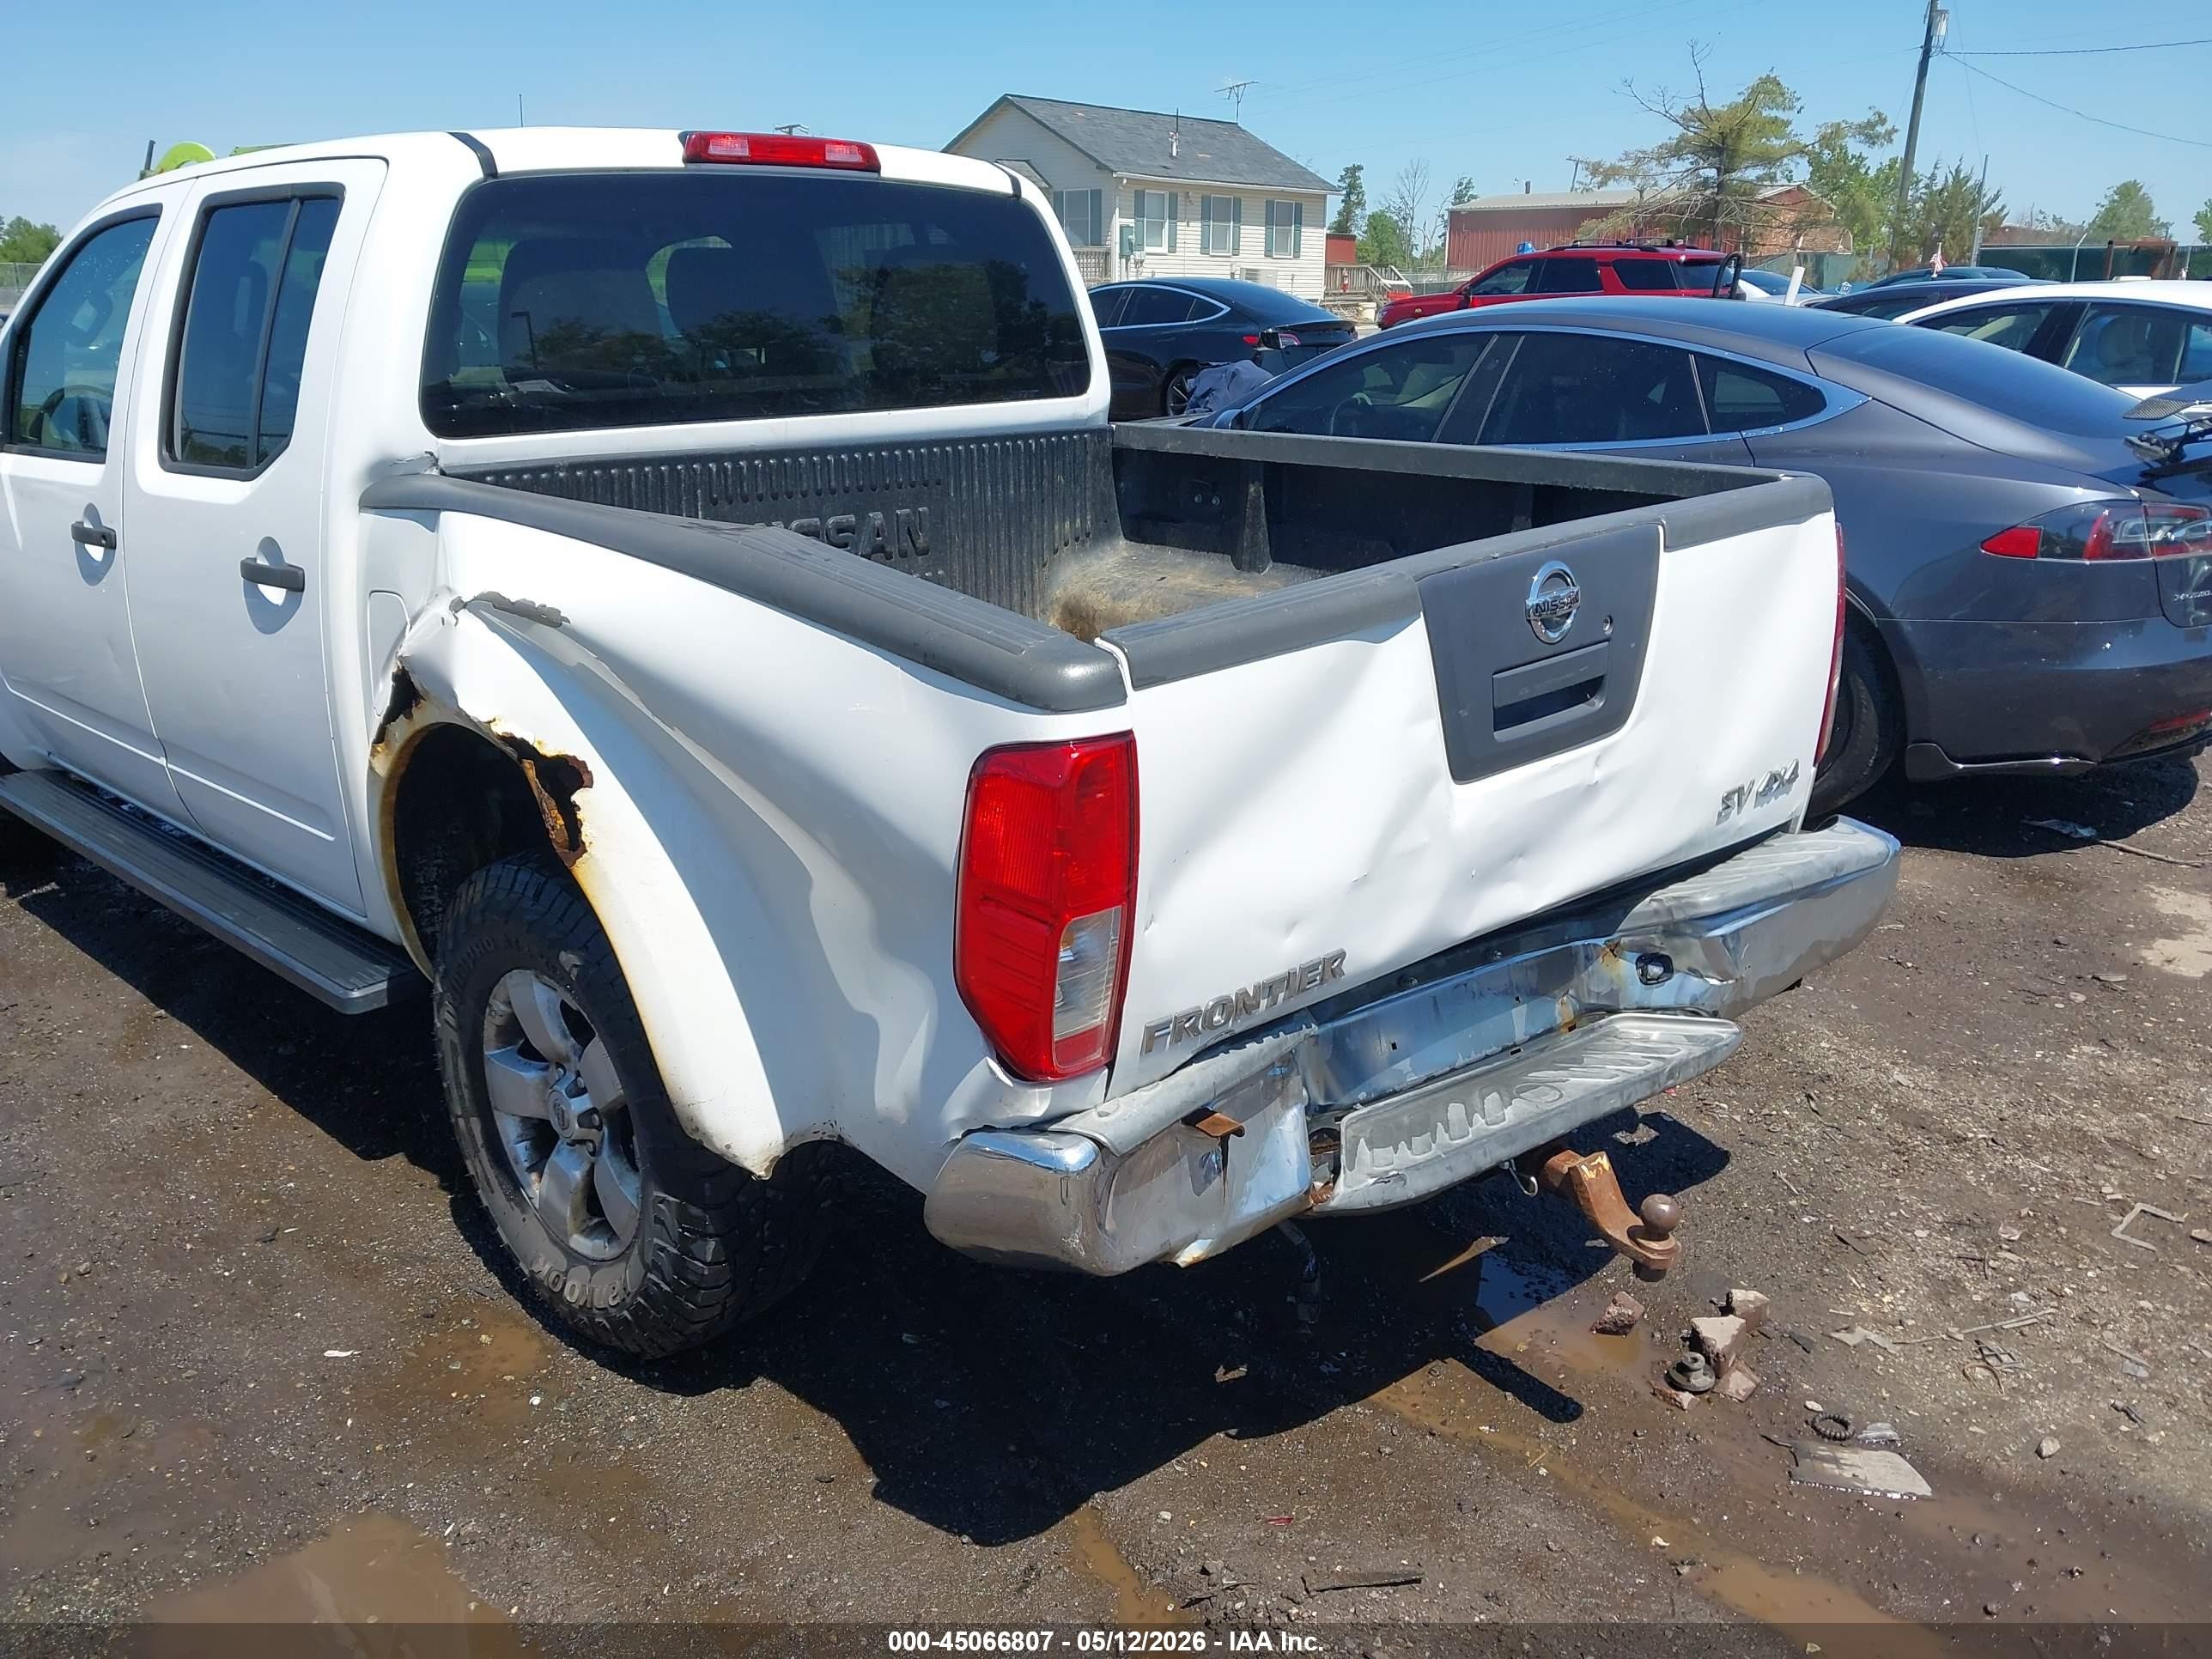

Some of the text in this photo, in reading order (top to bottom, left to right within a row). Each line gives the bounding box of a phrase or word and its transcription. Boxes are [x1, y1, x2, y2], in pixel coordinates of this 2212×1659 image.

[753, 507, 930, 561] SAN
[1534, 589, 1579, 616] NISSAN
[1719, 780, 1755, 812] SV
[1141, 948, 1347, 1055] FRONTIER
